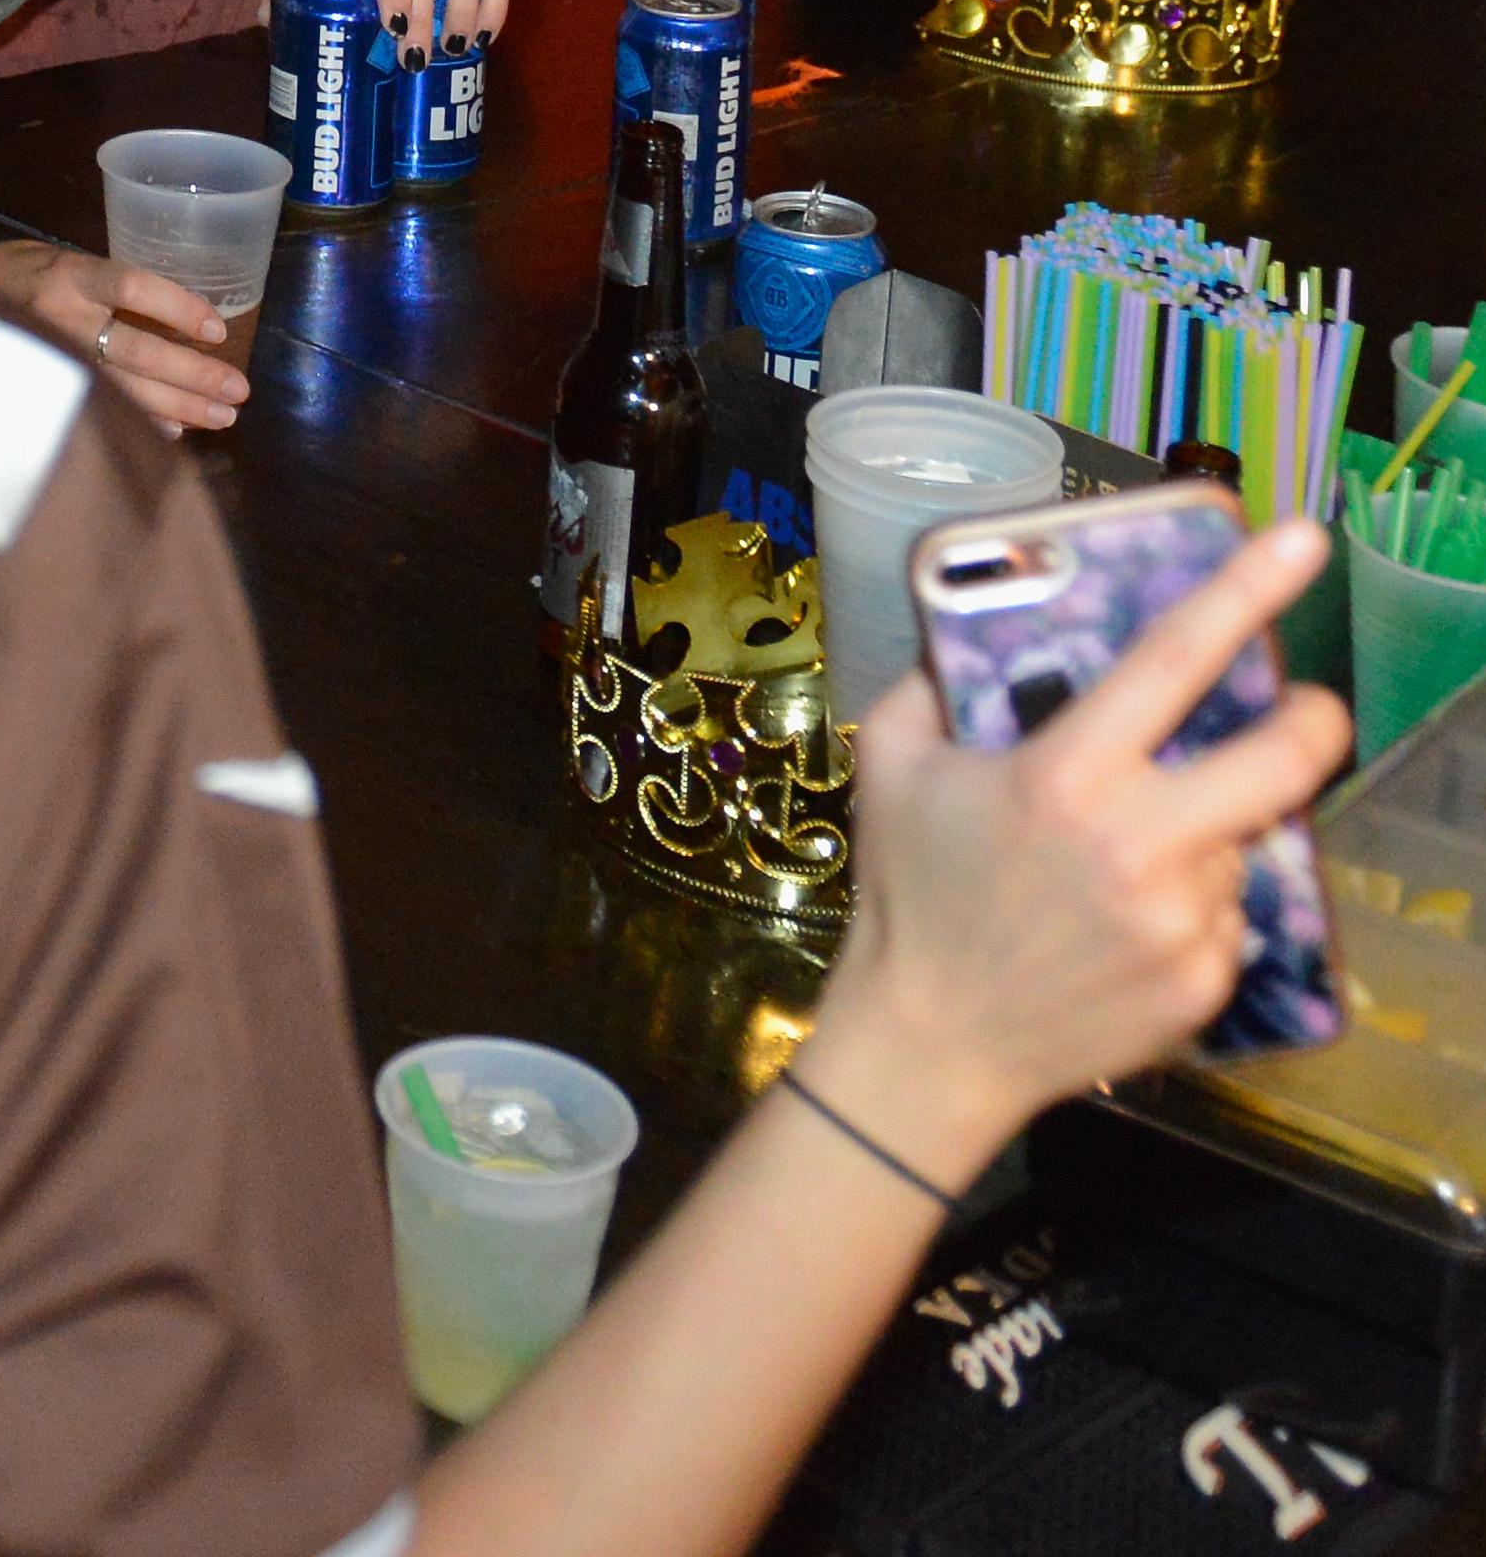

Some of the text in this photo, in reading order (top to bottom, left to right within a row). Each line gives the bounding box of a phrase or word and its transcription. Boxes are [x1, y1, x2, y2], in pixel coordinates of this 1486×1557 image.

[313, 24, 346, 195] BUD LIGHT
[714, 55, 742, 228] BUD LIGHT
